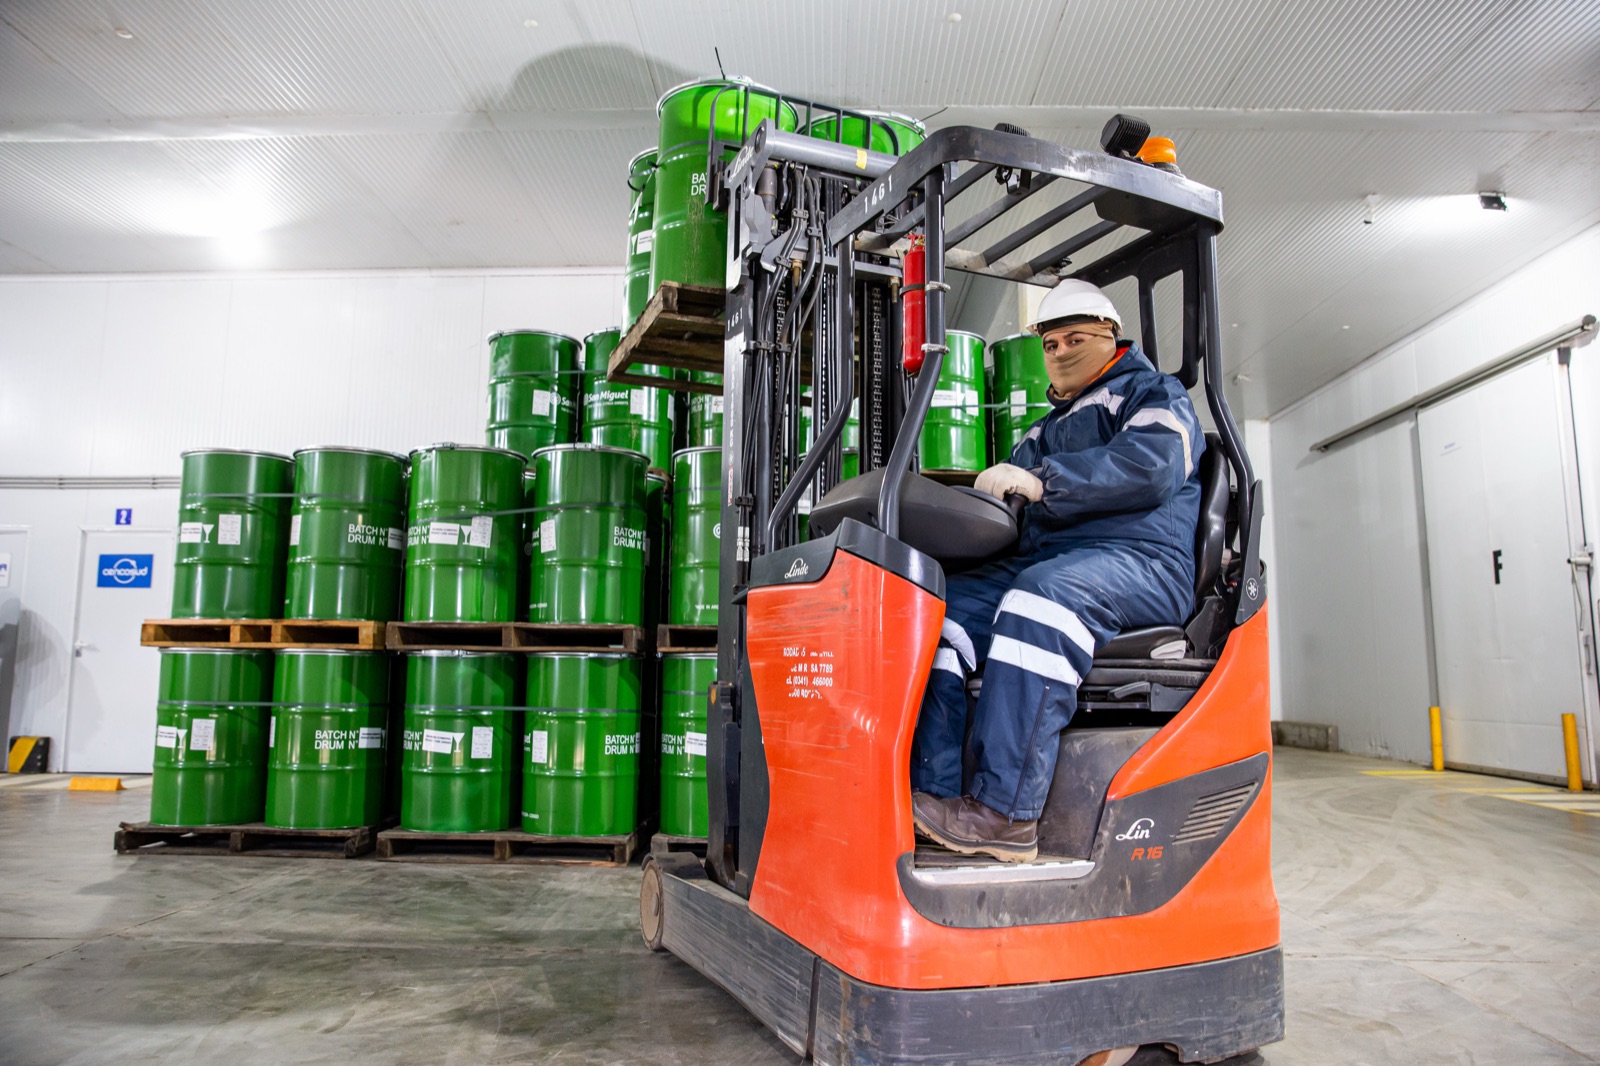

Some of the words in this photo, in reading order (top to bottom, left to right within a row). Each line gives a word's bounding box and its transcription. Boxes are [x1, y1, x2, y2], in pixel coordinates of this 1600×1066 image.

[588, 393, 600, 402] San
[600, 390, 629, 401] Miguel
[119, 509, 128, 525] 2
[348, 523, 378, 536] BATCH
[614, 526, 637, 539] BATCH
[347, 533, 376, 545] DRUM
[613, 537, 636, 549] DRUM
[102, 566, 149, 576] cencosud
[784, 557, 809, 579] Linde
[314, 730, 347, 740] BATCH
[604, 734, 629, 745] BATCH
[314, 740, 344, 750] DRUM
[604, 745, 628, 755] DRUM
